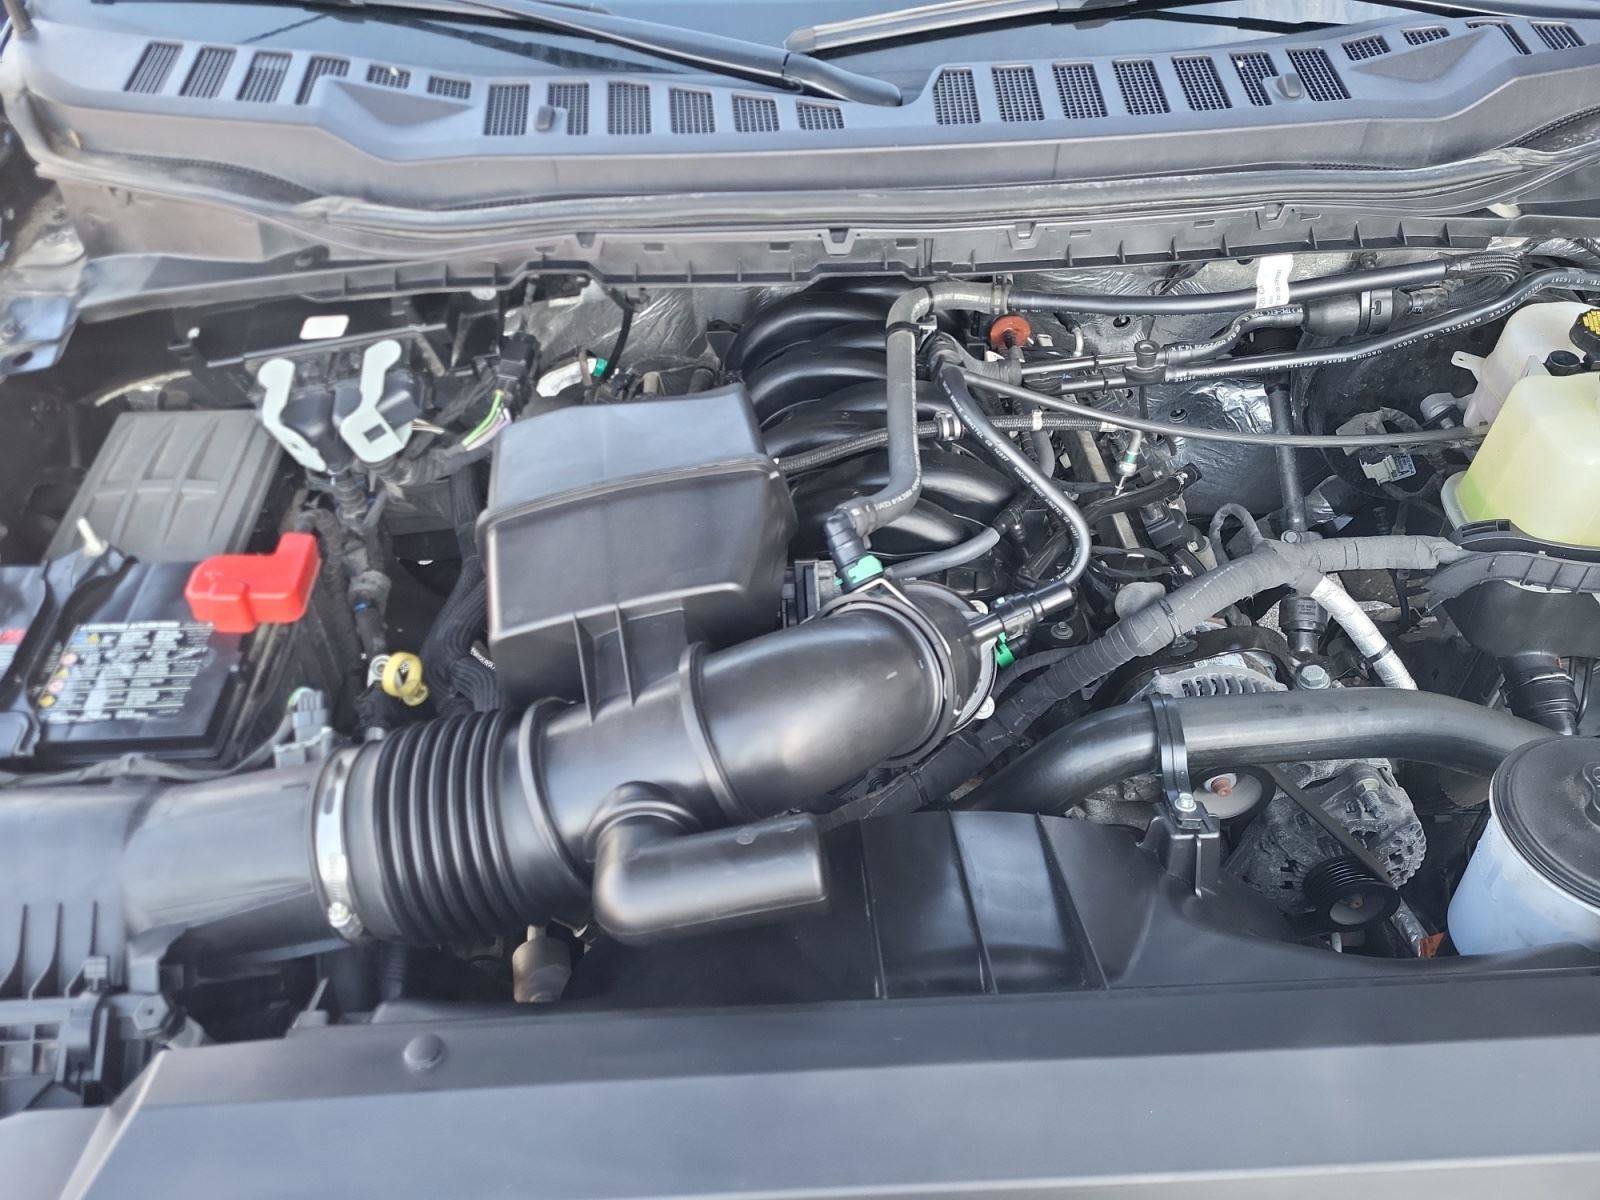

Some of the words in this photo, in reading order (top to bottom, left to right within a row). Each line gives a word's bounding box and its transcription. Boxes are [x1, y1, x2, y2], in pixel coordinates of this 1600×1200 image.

[1489, 302, 1517, 318] BRAKE
[1440, 317, 1482, 334] ARNITEL
[1352, 349, 1383, 361] VACUUM
